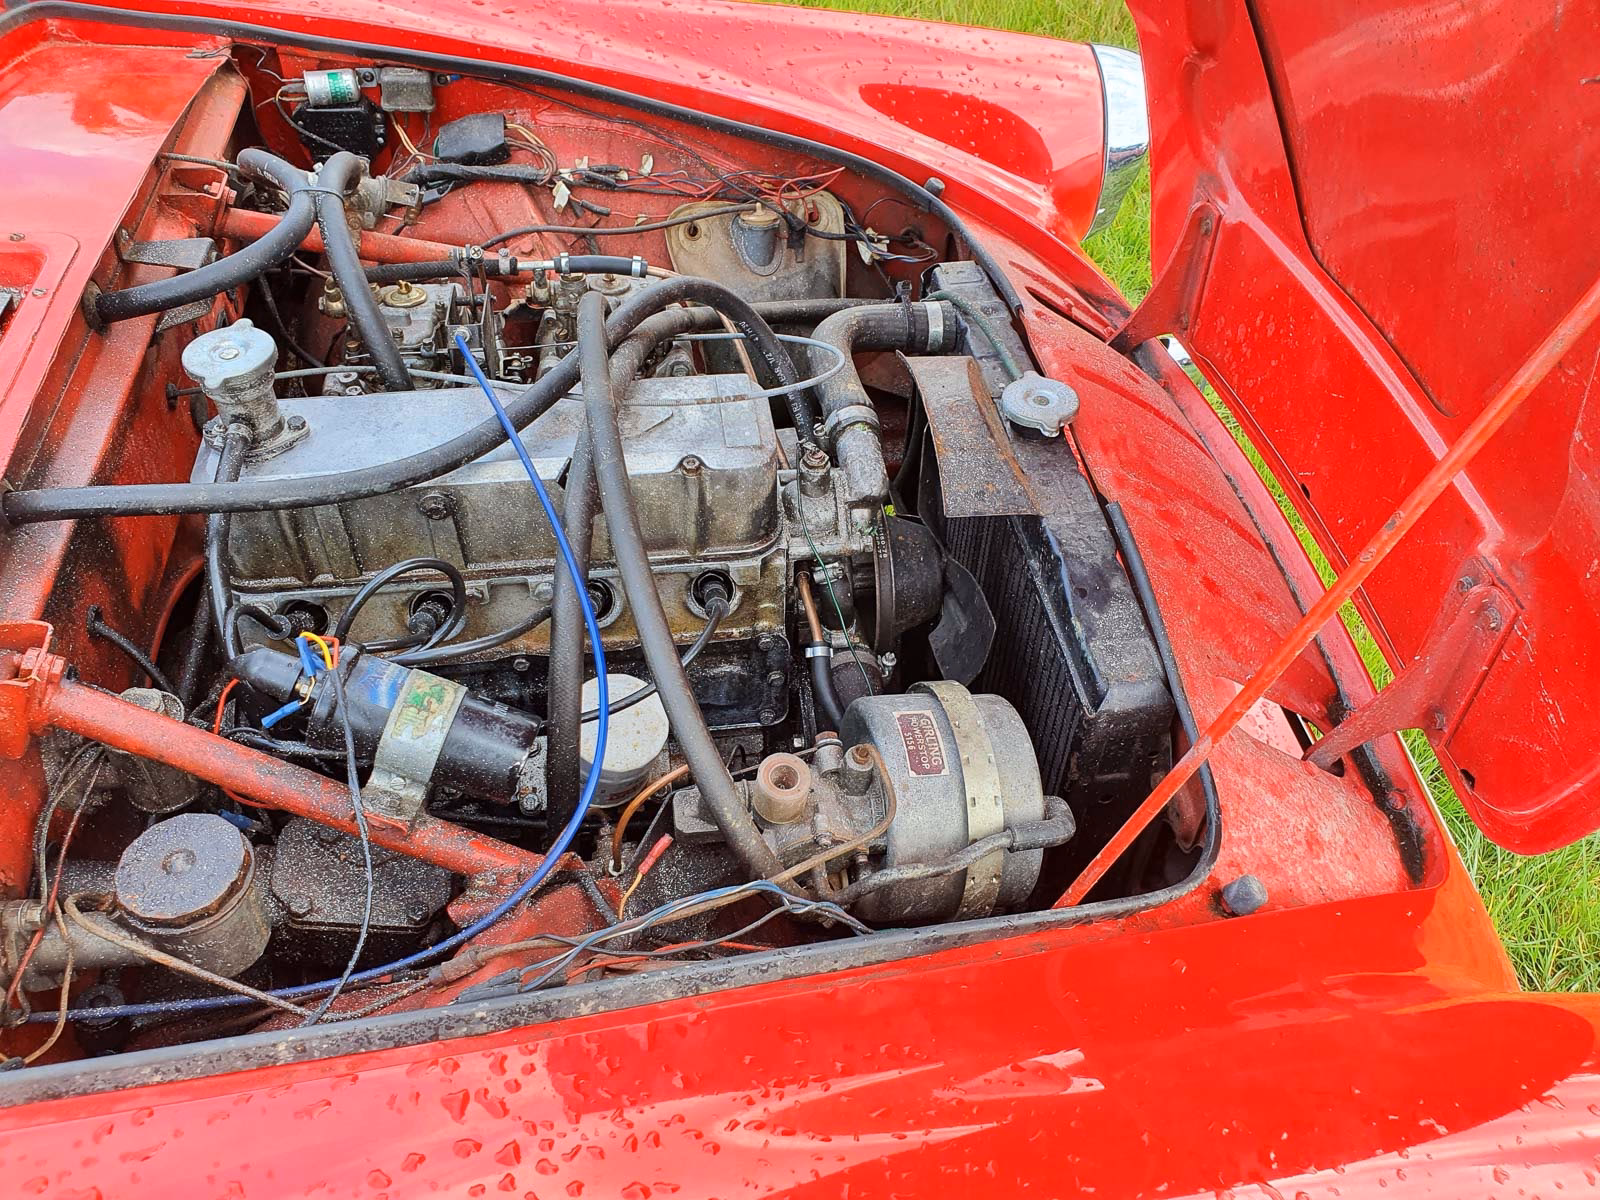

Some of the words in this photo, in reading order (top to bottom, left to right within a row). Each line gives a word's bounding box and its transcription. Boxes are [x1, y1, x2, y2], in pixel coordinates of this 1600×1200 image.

[904, 733, 916, 750] 5156
[909, 716, 931, 770] POWERSTOP
[920, 718, 942, 766] GIRLING
